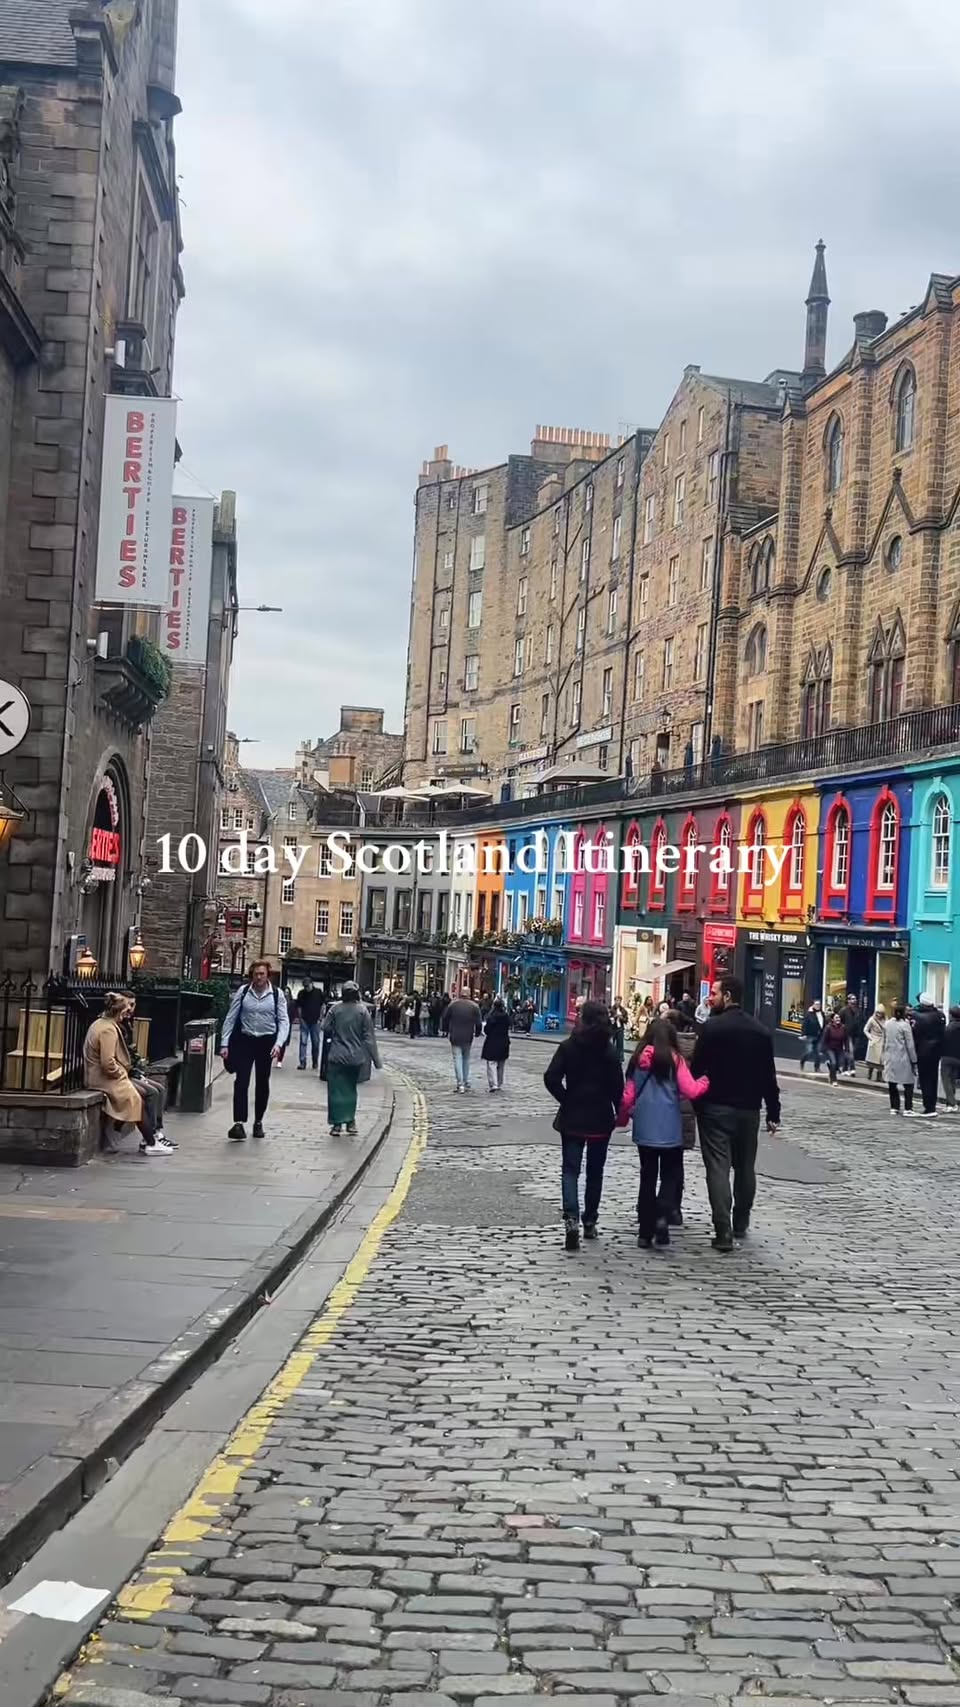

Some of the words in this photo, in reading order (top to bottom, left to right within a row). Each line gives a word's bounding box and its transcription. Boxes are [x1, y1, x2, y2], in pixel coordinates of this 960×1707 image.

[118, 411, 145, 588] BERTIES
[166, 507, 187, 650] BERTIES
[749, 931, 759, 941] THE
[760, 932, 781, 943] WHISKY
[782, 934, 798, 944] SHOP
